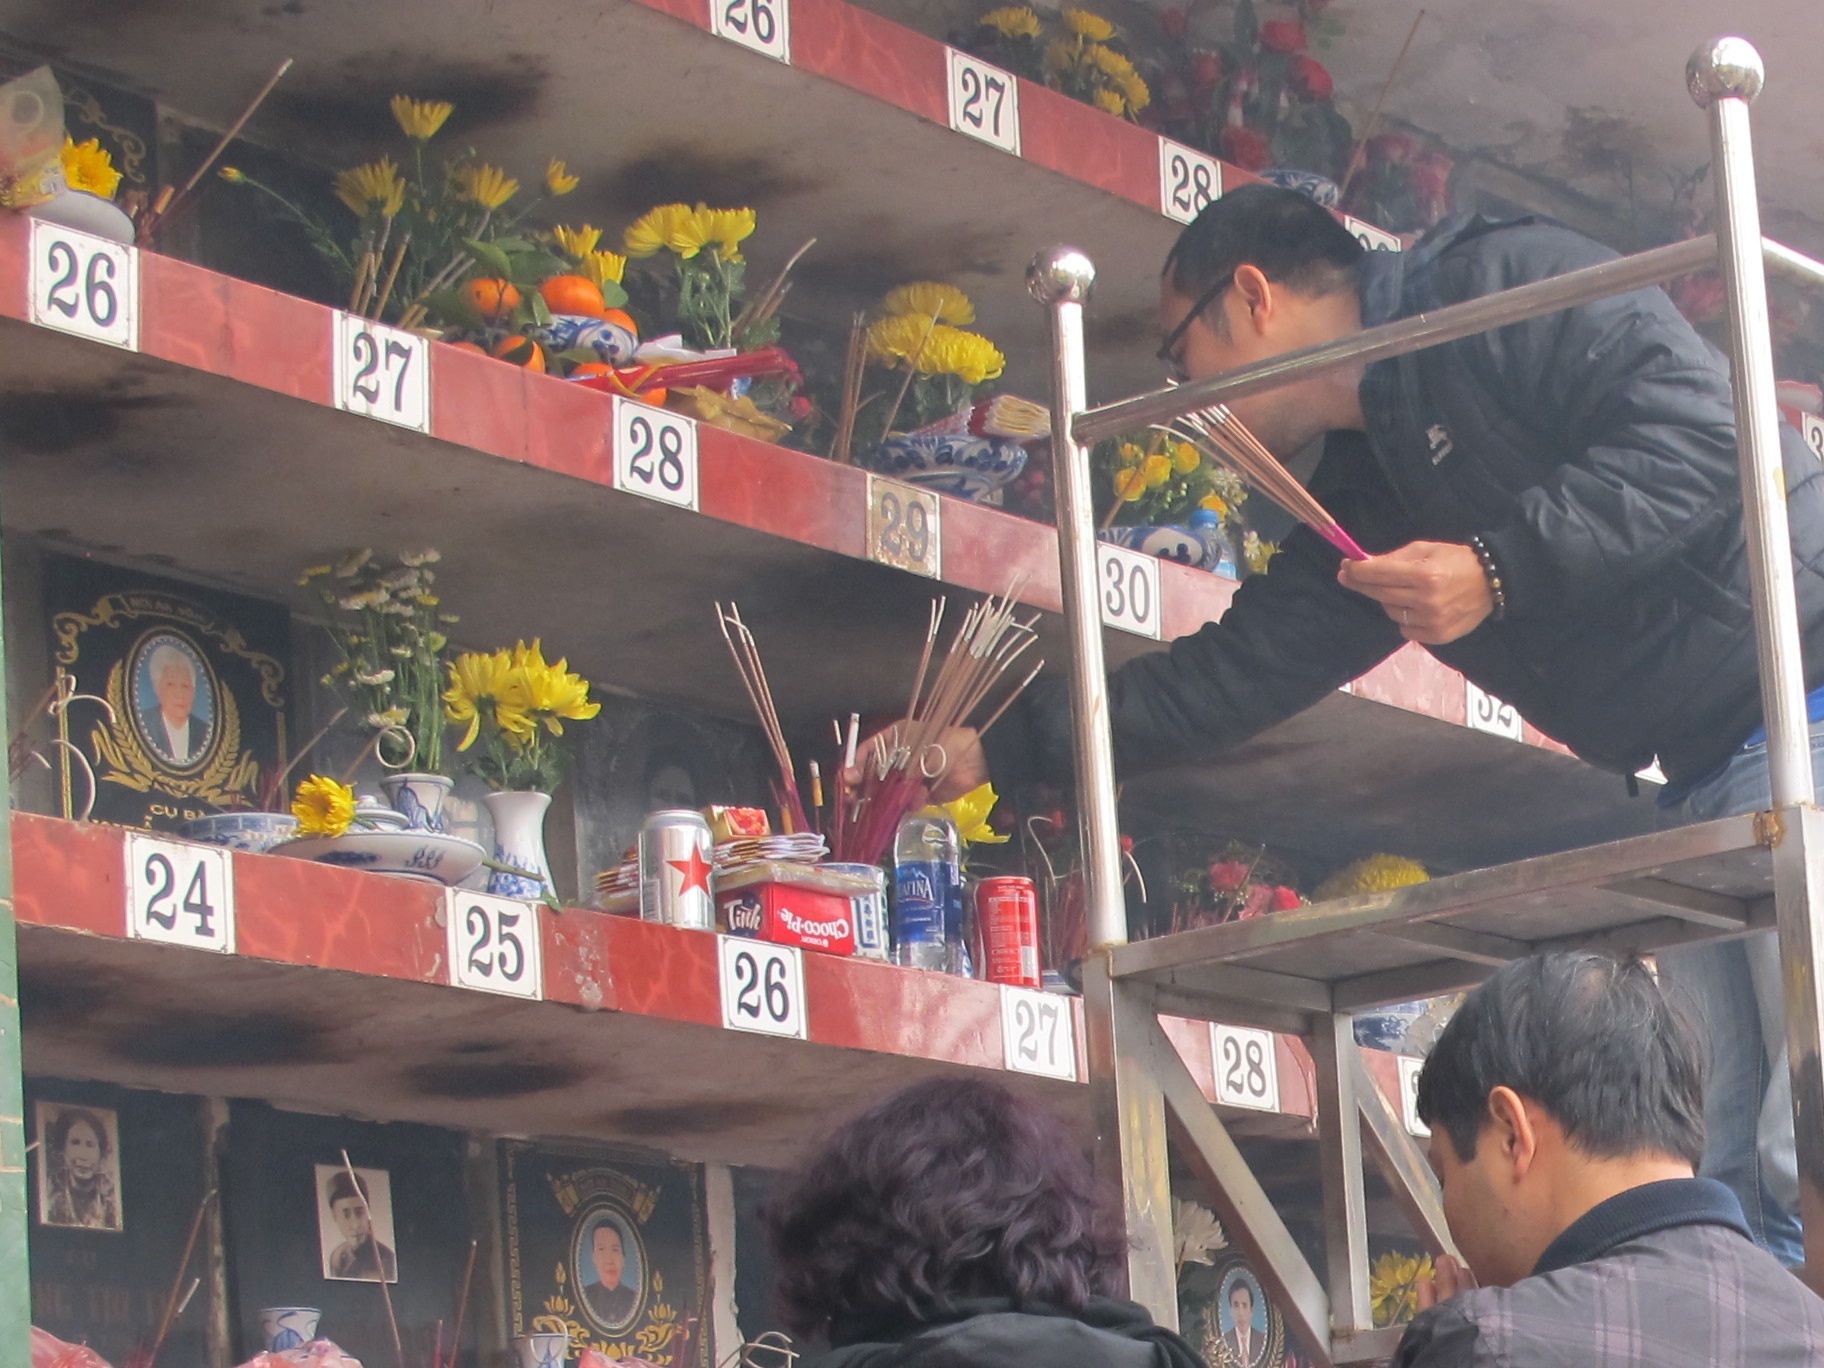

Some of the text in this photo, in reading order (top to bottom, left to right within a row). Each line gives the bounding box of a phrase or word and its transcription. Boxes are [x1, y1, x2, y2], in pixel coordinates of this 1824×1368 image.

[724, 0, 775, 44] 26
[963, 68, 1005, 136] 27
[1172, 155, 1211, 212] 28
[48, 241, 117, 327] 26
[353, 332, 413, 411] 27
[630, 416, 684, 490] 28
[880, 492, 928, 562] 29
[1106, 558, 1150, 623] 30
[146, 854, 214, 937] 24
[781, 907, 849, 940] Choco-Pie
[466, 906, 524, 981] 25
[736, 952, 789, 1022] 26
[1017, 1001, 1058, 1065] 27
[1224, 1036, 1266, 1097] 28
